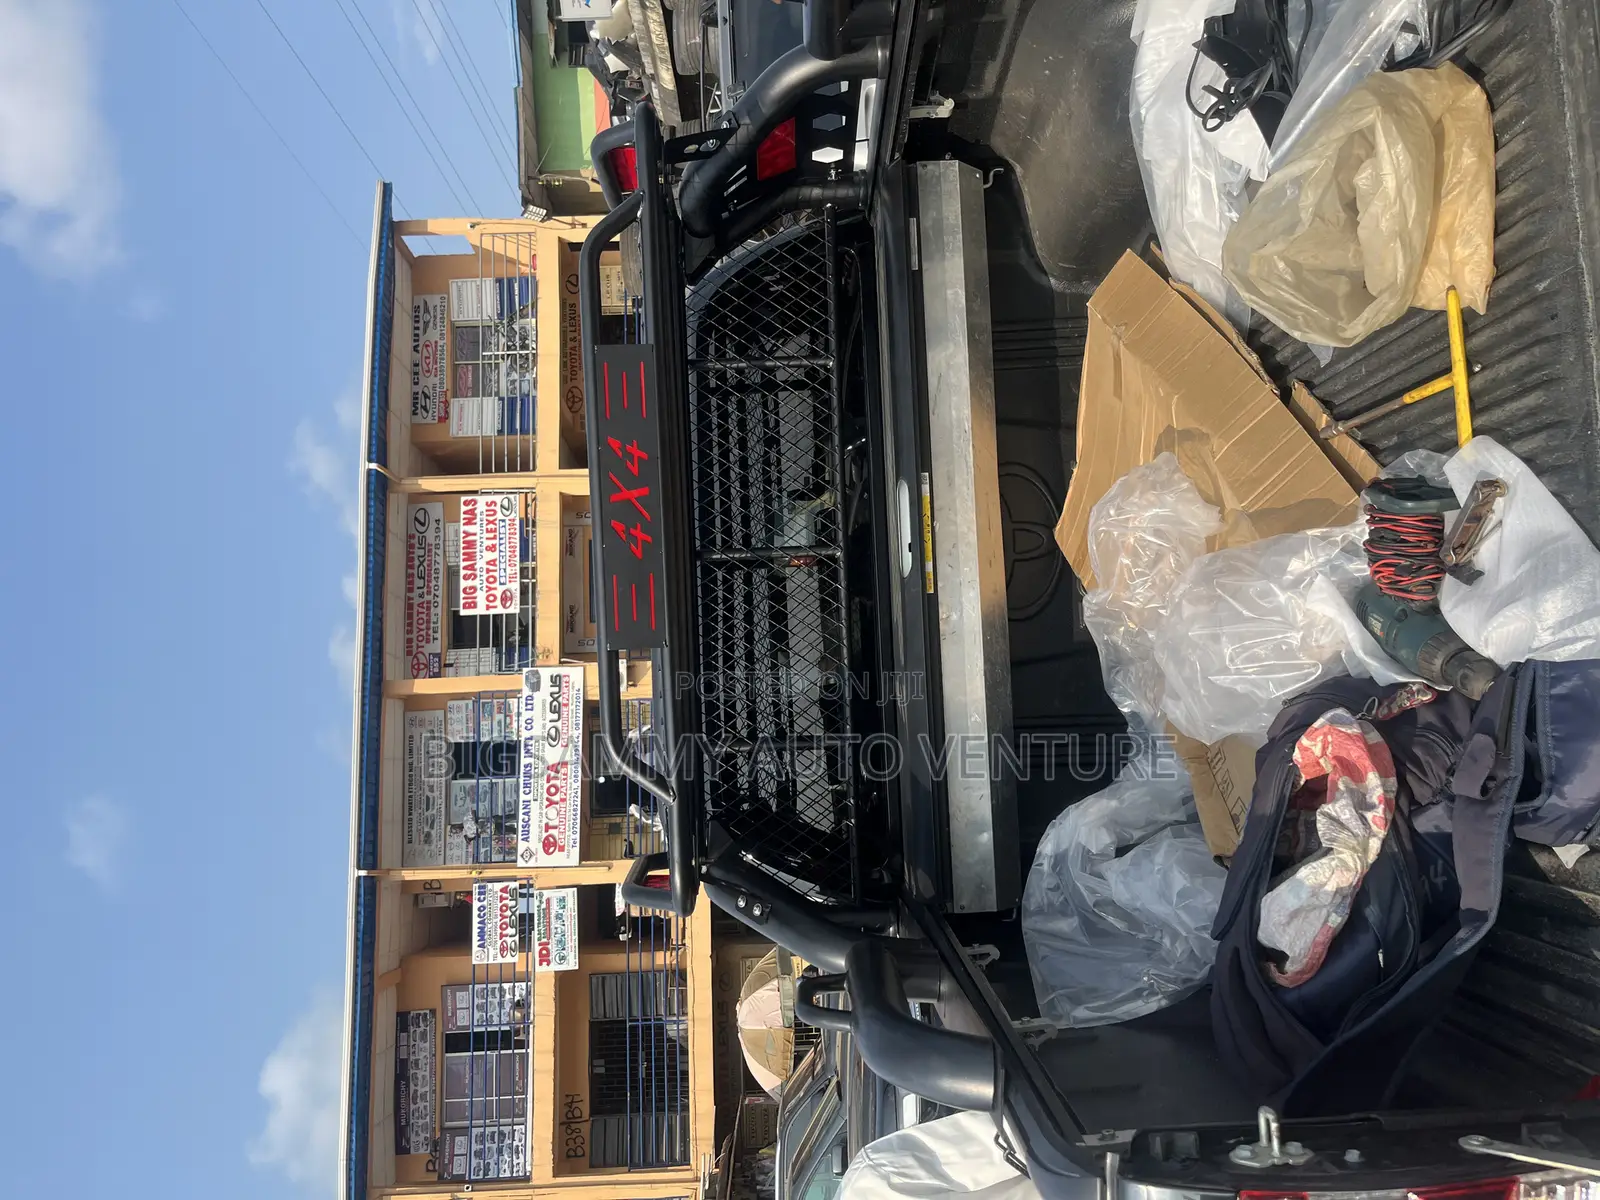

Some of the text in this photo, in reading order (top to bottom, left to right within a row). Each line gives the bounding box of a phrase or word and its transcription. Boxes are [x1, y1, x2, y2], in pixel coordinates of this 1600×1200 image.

[569, 303, 577, 333] LEXUS
[569, 346, 578, 382] TOYOTA
[412, 391, 420, 416] MR
[607, 435, 652, 560] 4X4
[417, 535, 426, 590] LEXUS
[433, 518, 441, 608] 07048778394
[463, 498, 478, 610] BIG SAMMY NAS
[486, 500, 497, 610] TOYOTA & LEXUS
[508, 518, 517, 583] TEL: 07048778394
[407, 573, 415, 594] NAS
[406, 596, 414, 635] SAMMY
[416, 601, 426, 650] TOYOTA
[525, 693, 534, 711] LTD.
[549, 674, 561, 723] LEXUS
[525, 716, 533, 731] CO.
[522, 763, 532, 795] CHUKS
[544, 761, 560, 833] TOYOTA
[521, 800, 531, 843] AUSCANI
[477, 905, 486, 949] AMMACO
[499, 885, 509, 940] TOYOTA
[509, 887, 519, 937] LEXUS
[538, 941, 551, 966] JDI
